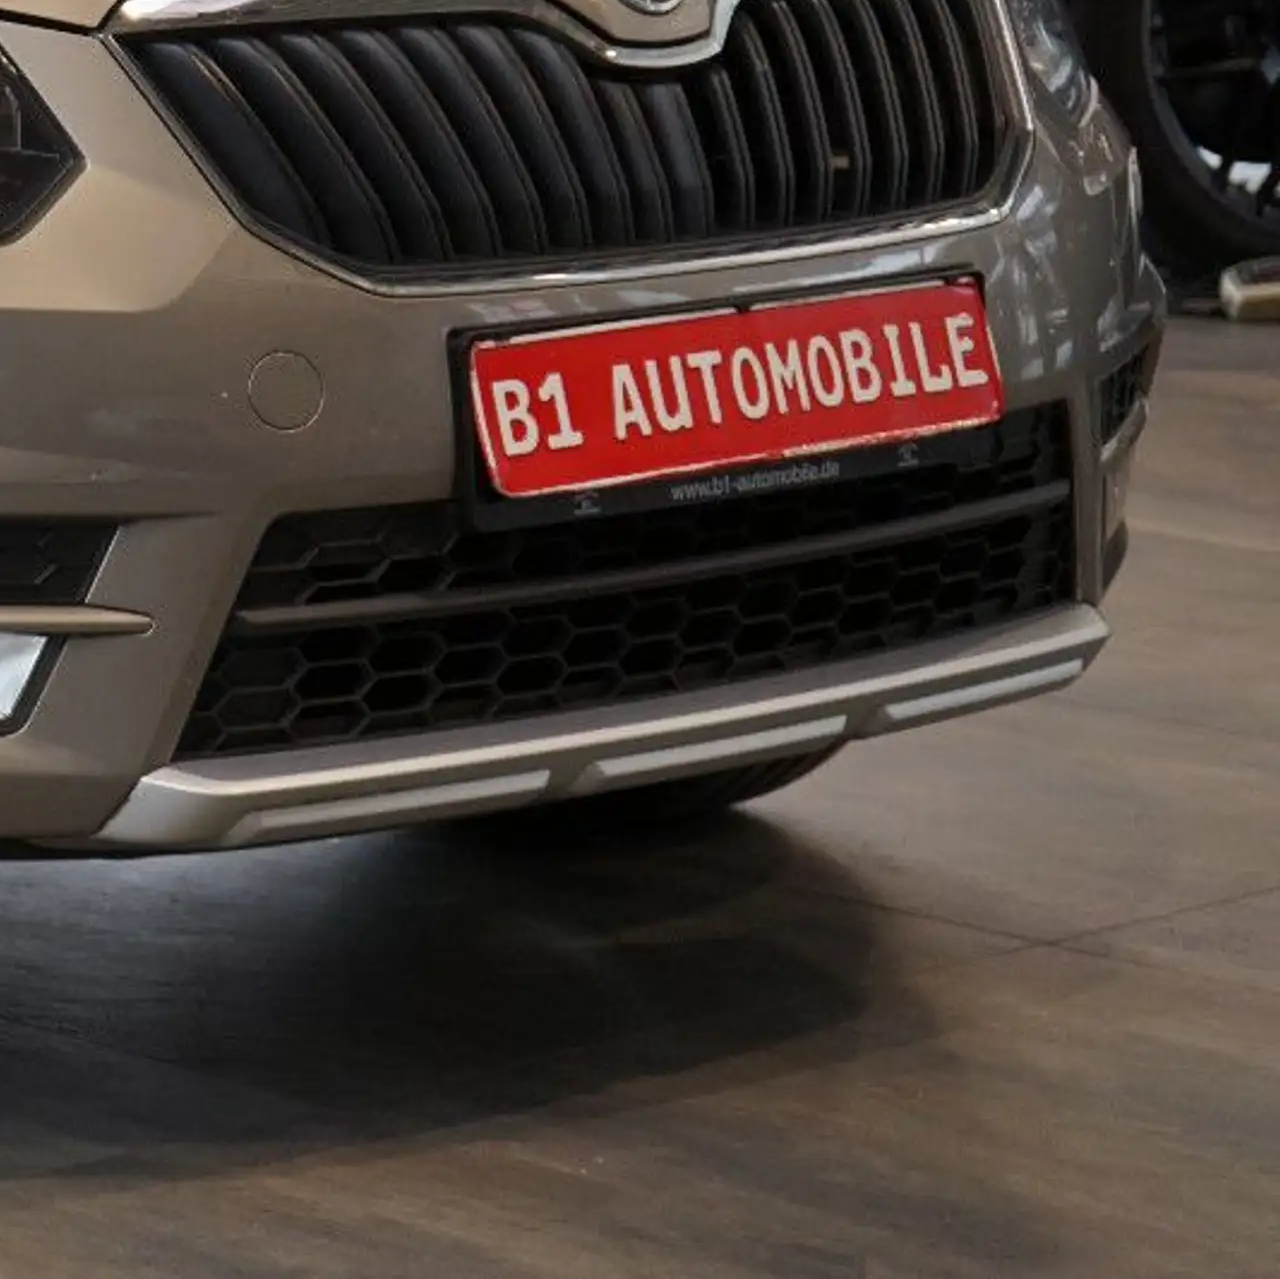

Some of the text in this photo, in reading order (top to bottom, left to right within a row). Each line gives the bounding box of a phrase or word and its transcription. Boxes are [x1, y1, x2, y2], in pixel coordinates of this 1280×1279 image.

[491, 312, 990, 458] B1 AUTOMOBILE
[669, 459, 840, 504] www.b1-automobile.de
